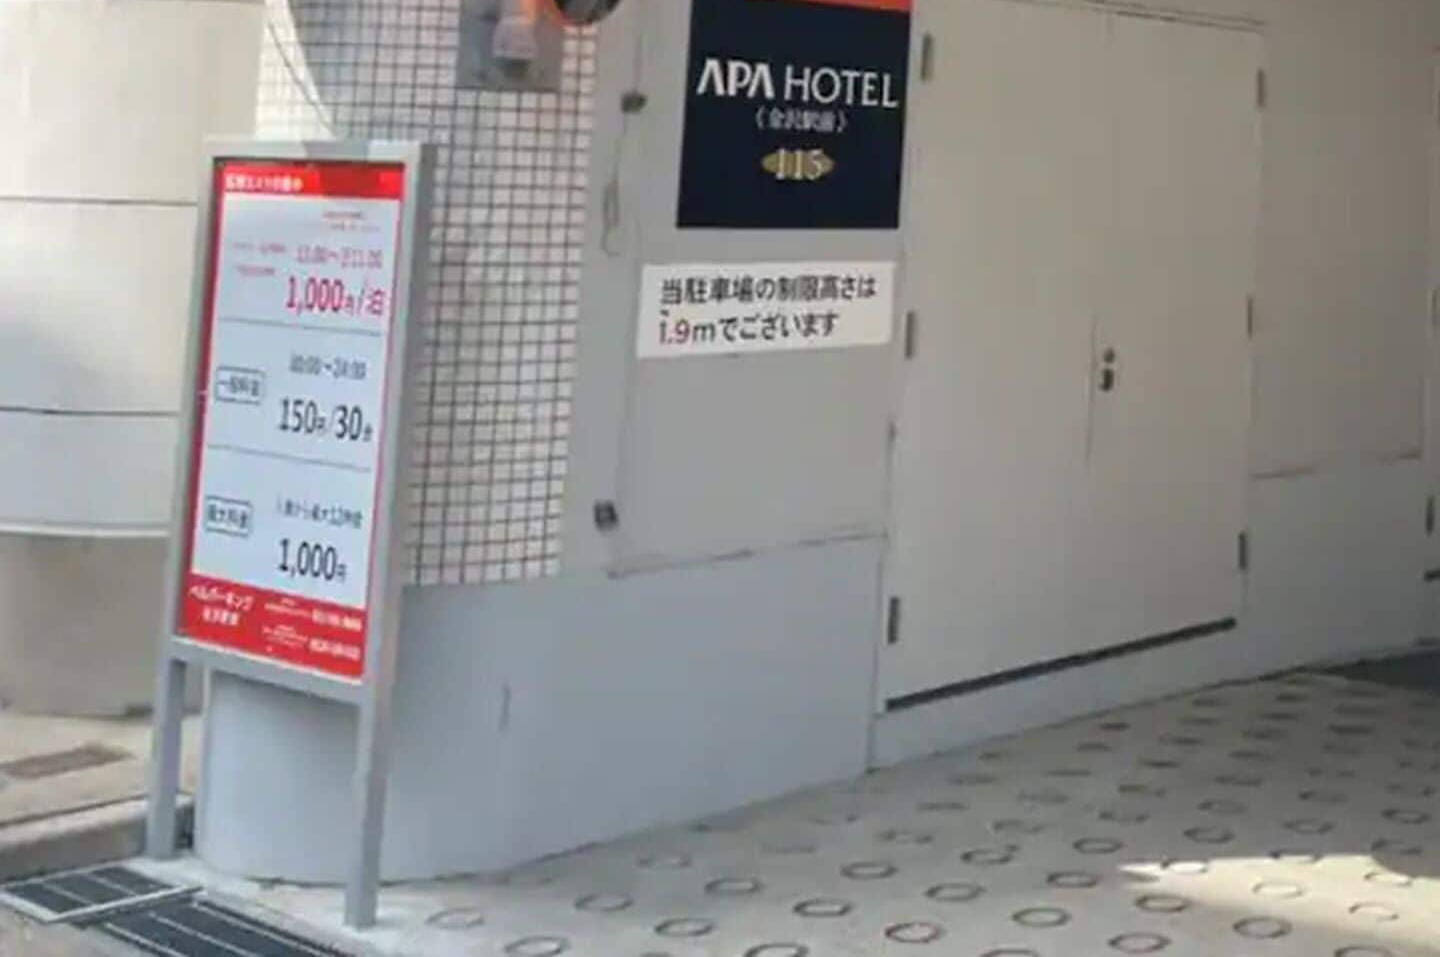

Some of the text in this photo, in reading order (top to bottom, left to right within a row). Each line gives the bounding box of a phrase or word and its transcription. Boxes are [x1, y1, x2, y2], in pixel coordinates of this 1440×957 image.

[696, 58, 898, 108] APA HOTEL
[660, 274, 877, 305] 当駐車場の制限高さは
